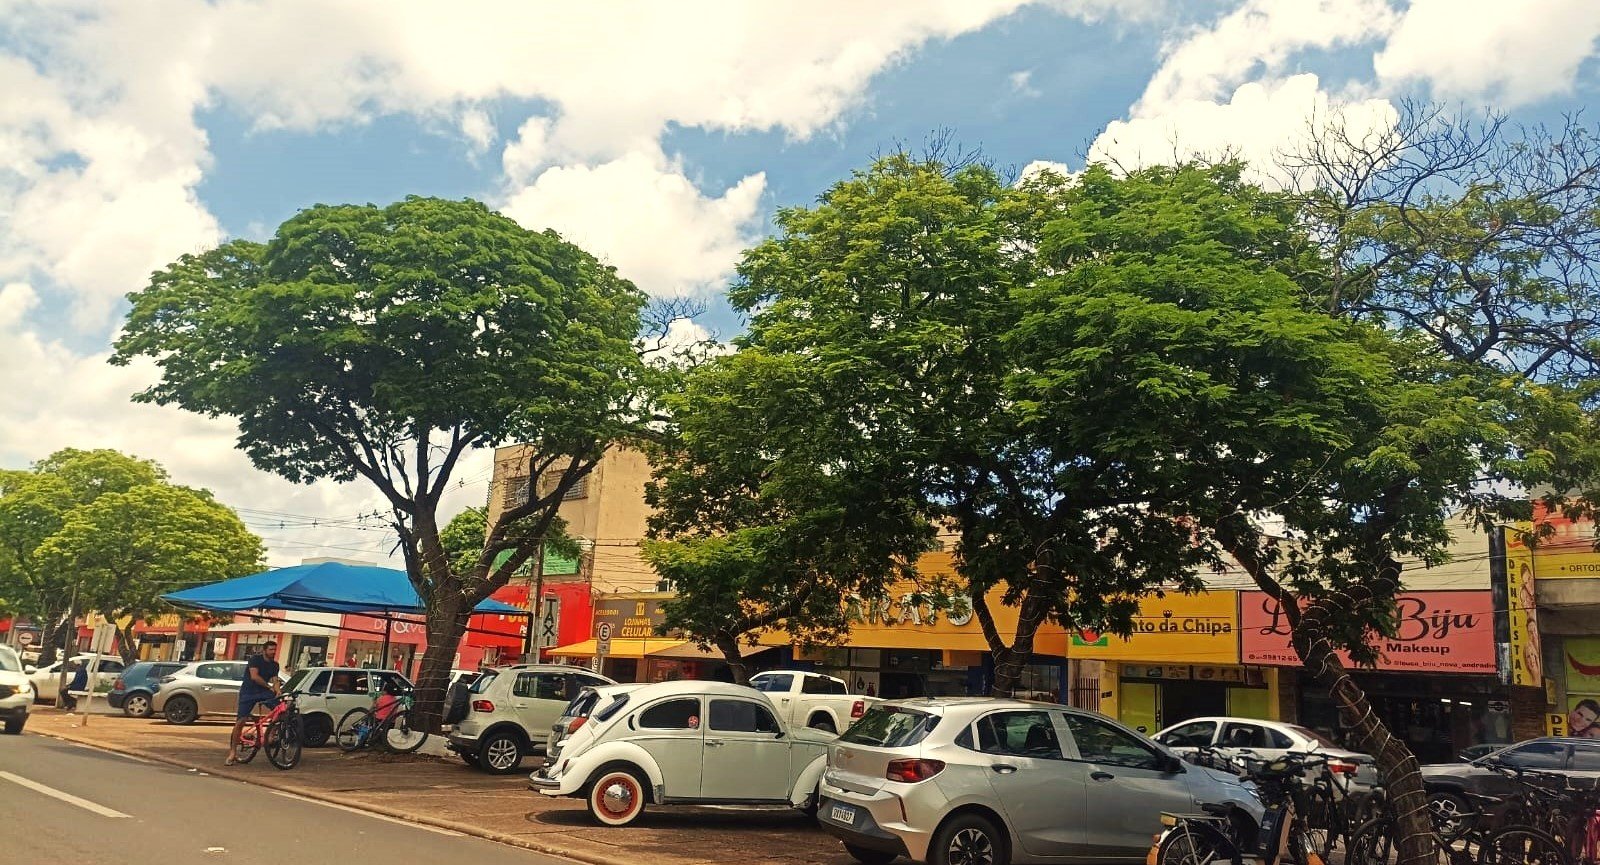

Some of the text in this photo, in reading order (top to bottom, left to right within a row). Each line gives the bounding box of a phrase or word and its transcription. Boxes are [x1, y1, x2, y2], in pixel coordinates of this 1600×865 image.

[543, 599, 557, 646] TAXI
[1131, 618, 1232, 636] nto da Chipa
[1385, 597, 1480, 641] Biju
[1509, 559, 1522, 685] DENTISTAS
[602, 626, 608, 638] E
[621, 627, 652, 637] CELULAR
[1386, 643, 1450, 656] Makeup
